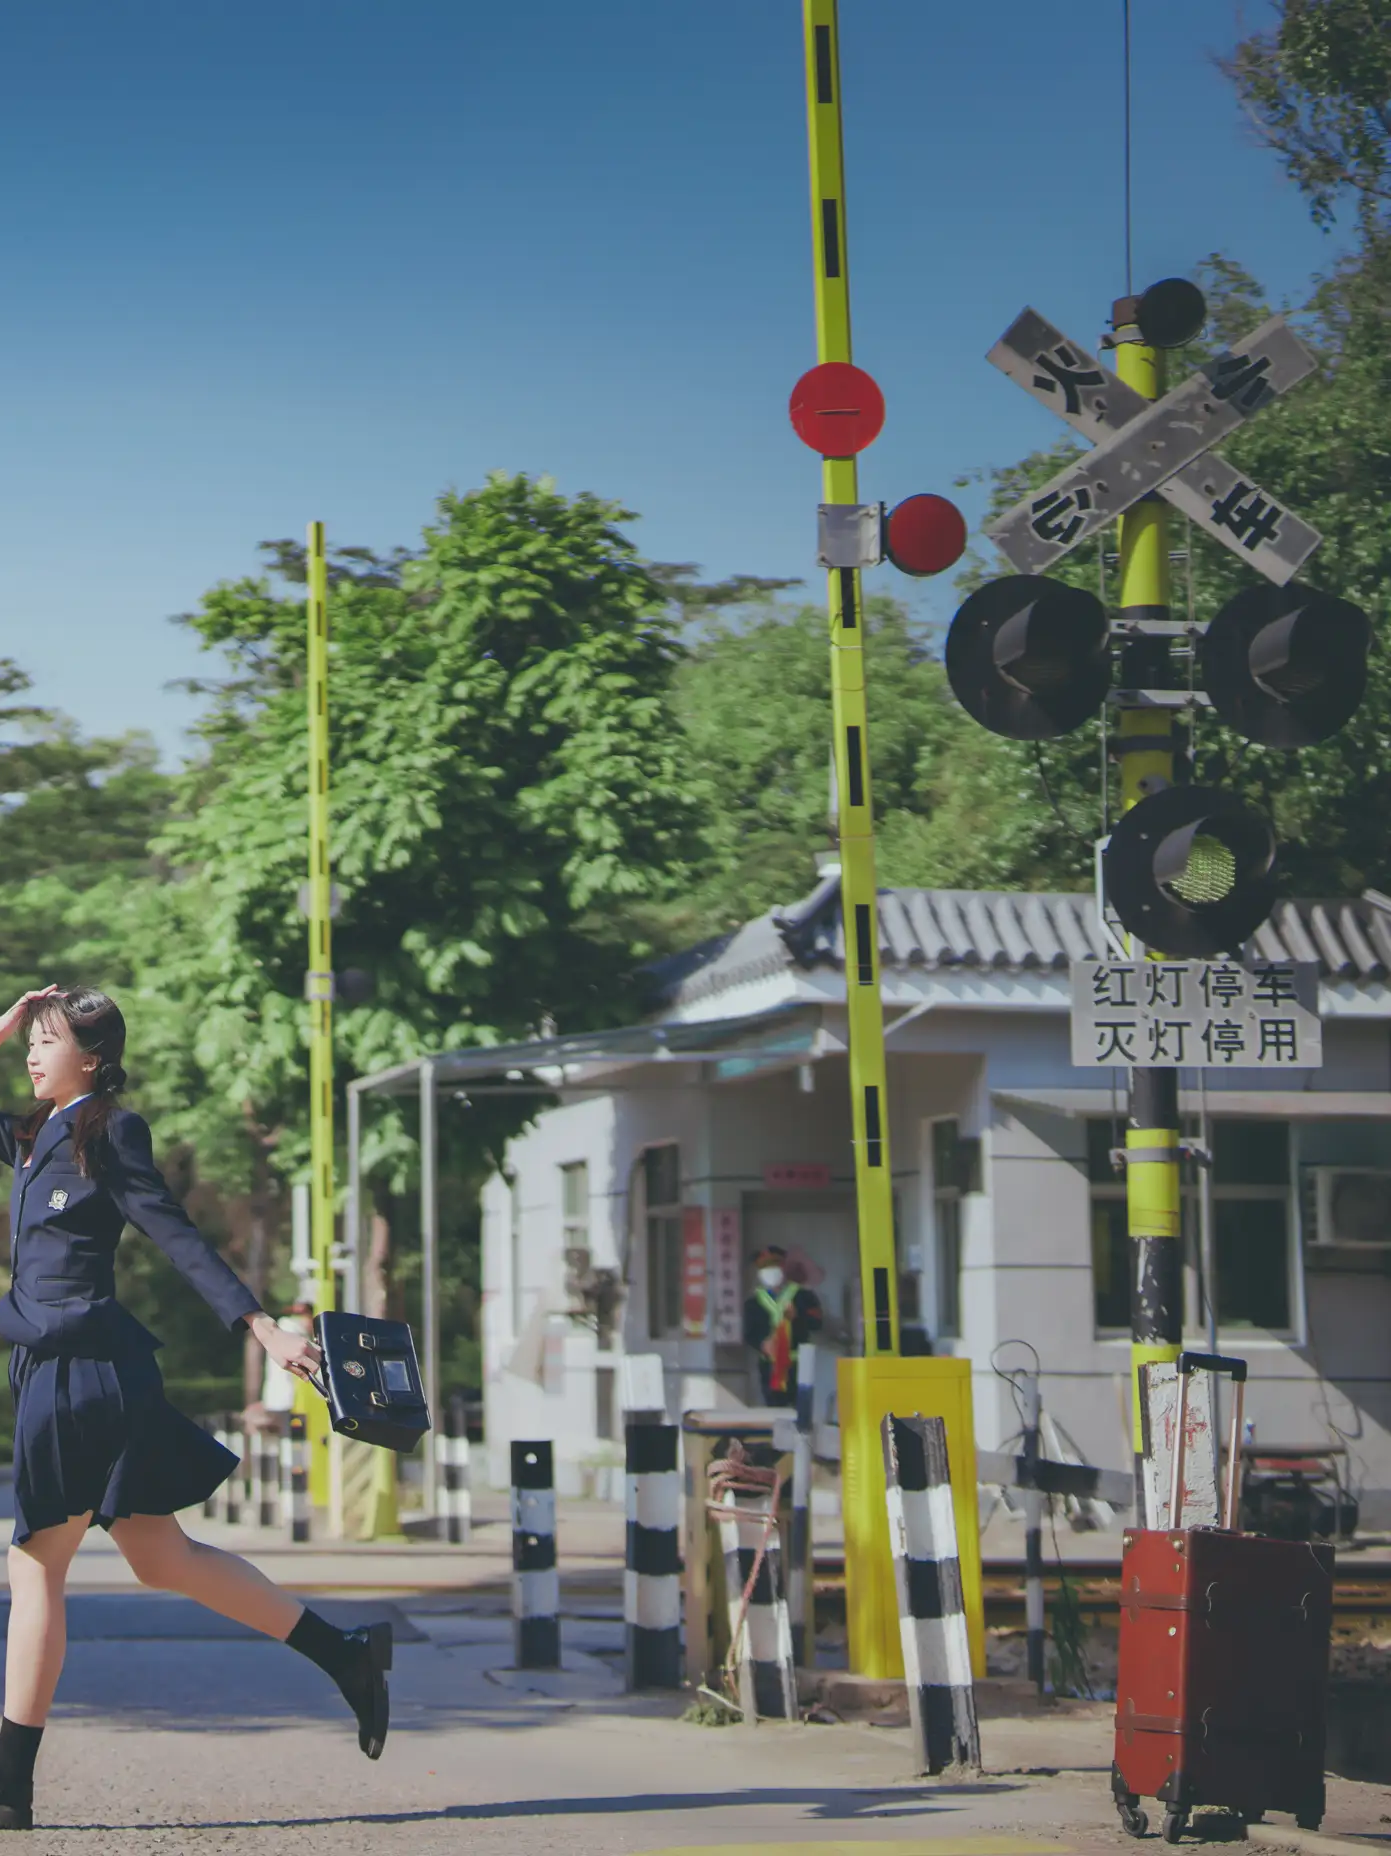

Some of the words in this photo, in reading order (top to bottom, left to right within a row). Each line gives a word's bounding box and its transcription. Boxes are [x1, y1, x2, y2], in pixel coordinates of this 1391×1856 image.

[1092, 964, 1298, 1008] 红灯停车
[1094, 1018, 1299, 1063] 灭灯停用
